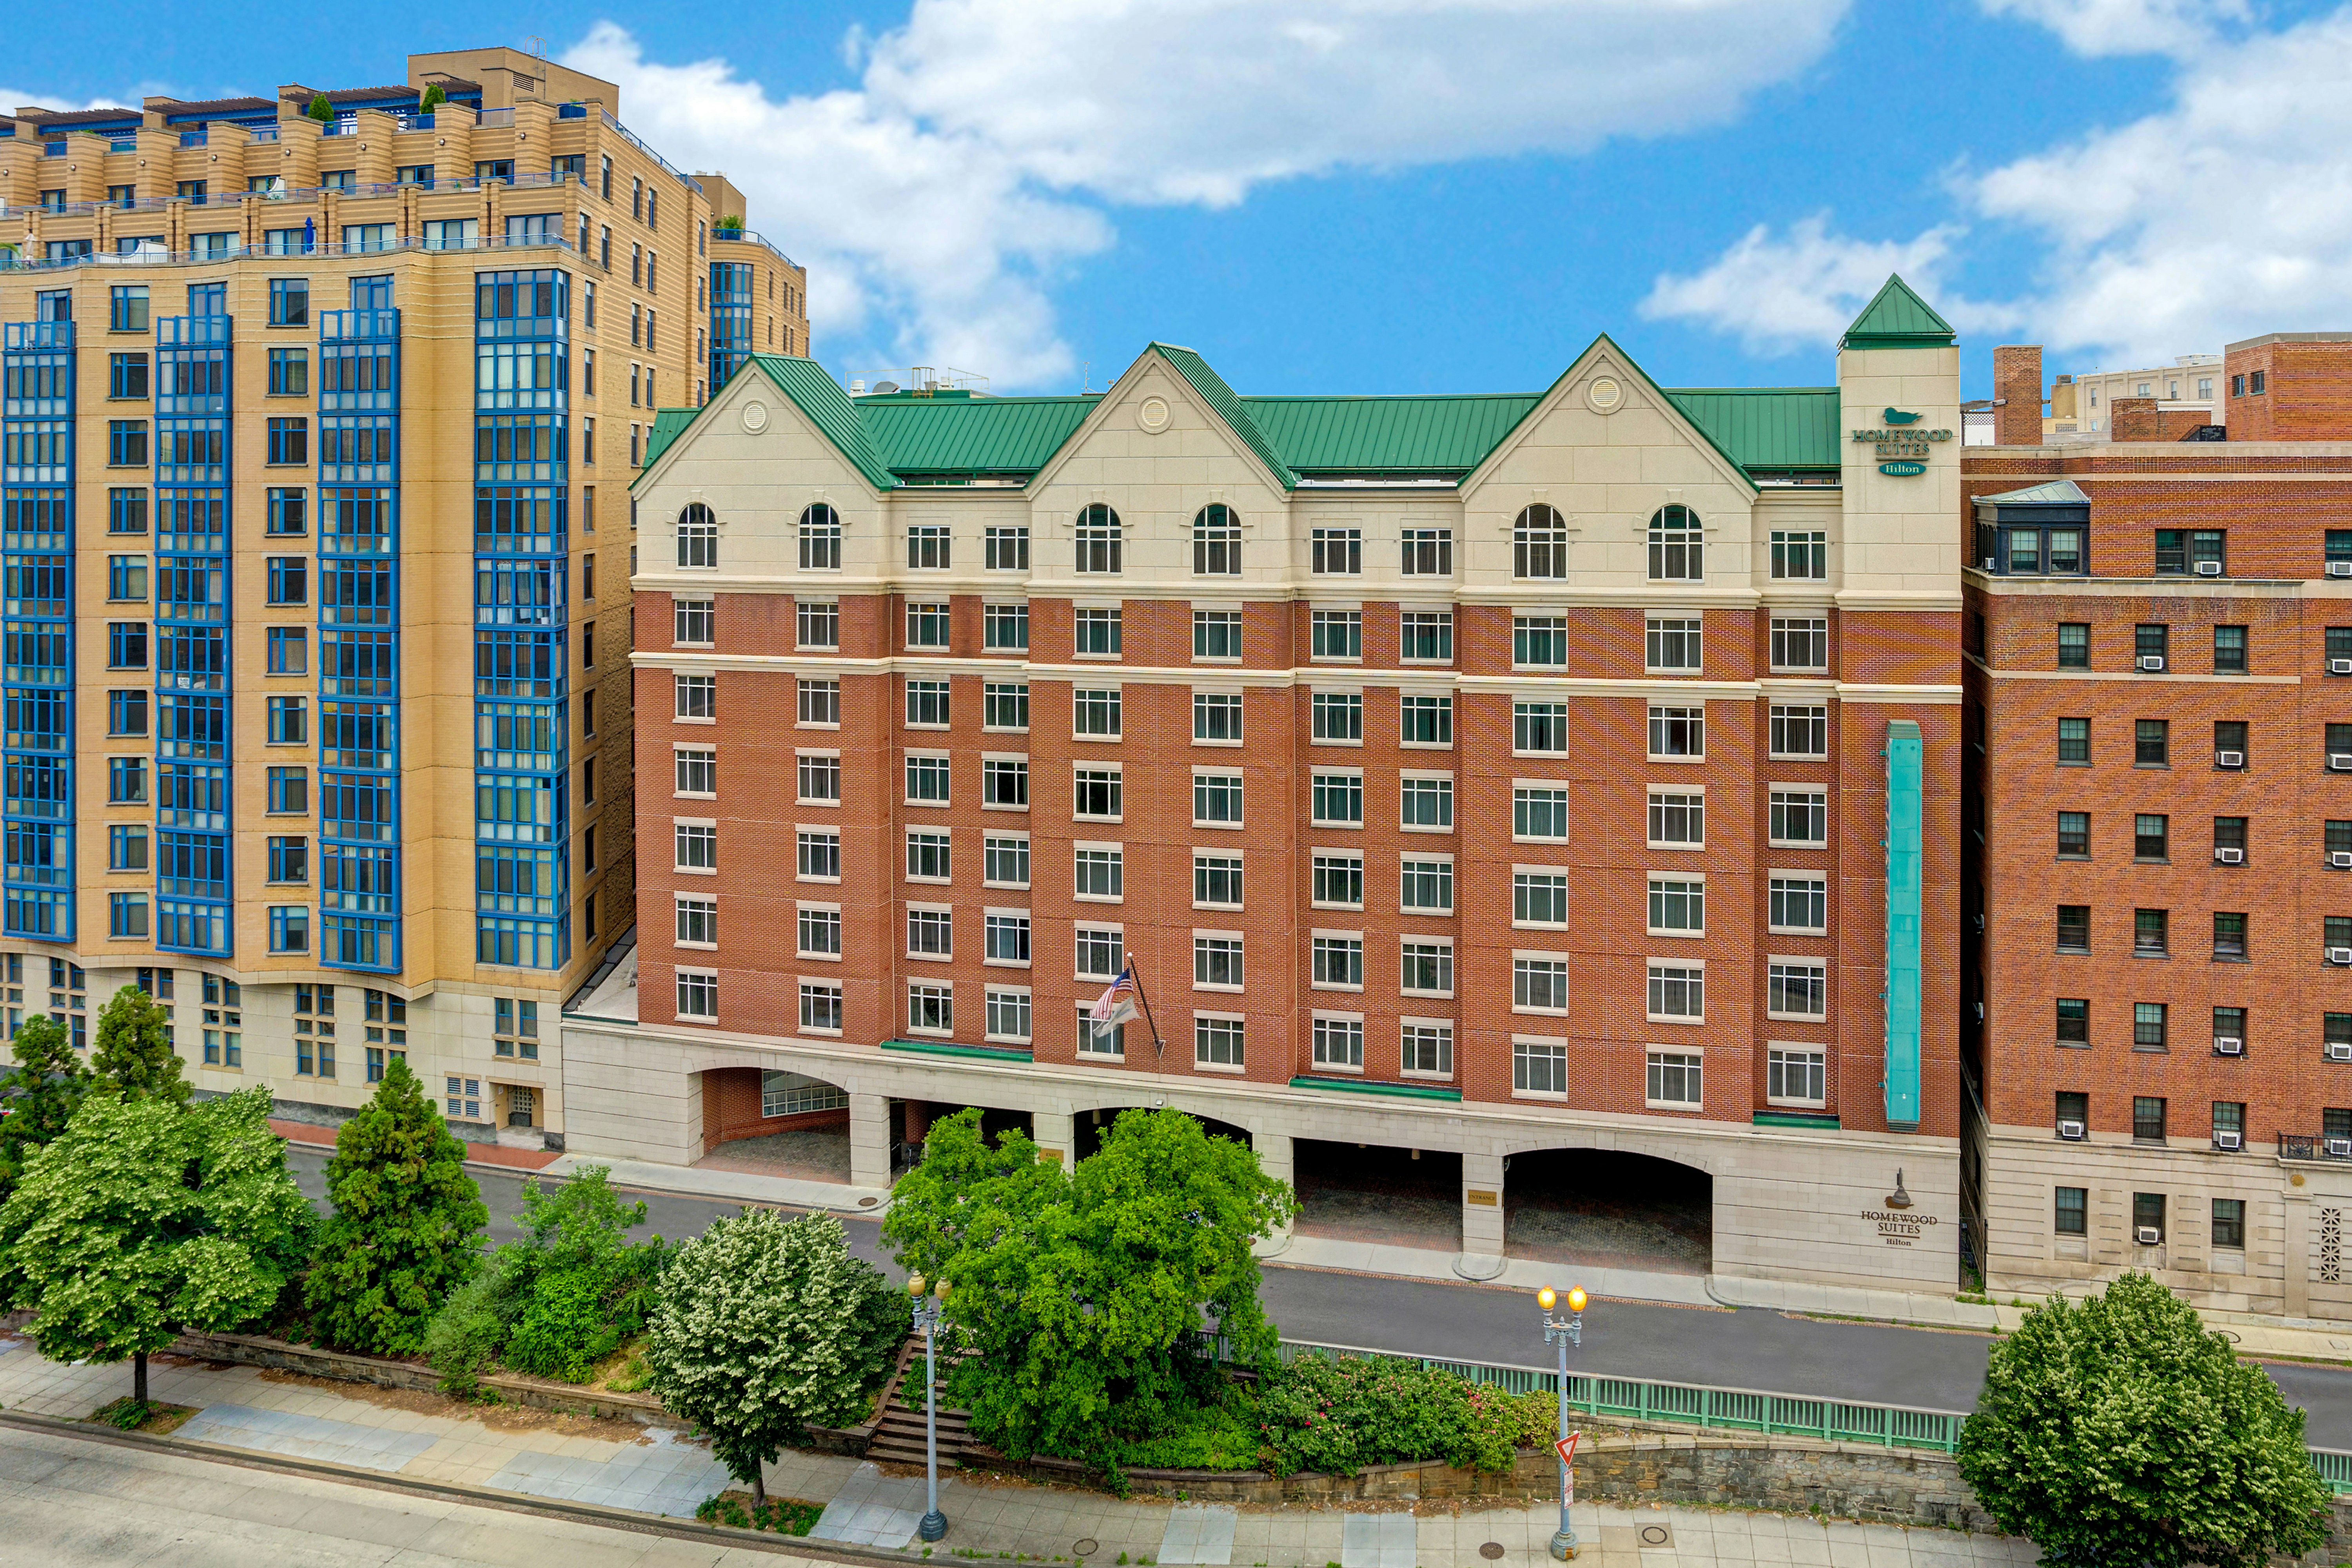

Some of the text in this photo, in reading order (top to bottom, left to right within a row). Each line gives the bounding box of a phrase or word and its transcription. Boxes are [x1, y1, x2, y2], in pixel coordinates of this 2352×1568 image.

[1853, 429, 1953, 442] HOMEWOOD
[1875, 443, 1930, 454] SUITES
[1886, 465, 1919, 473] Hilton
[1861, 1211, 1937, 1225] HOMEWOOD
[1878, 1222, 1920, 1234] SUITES
